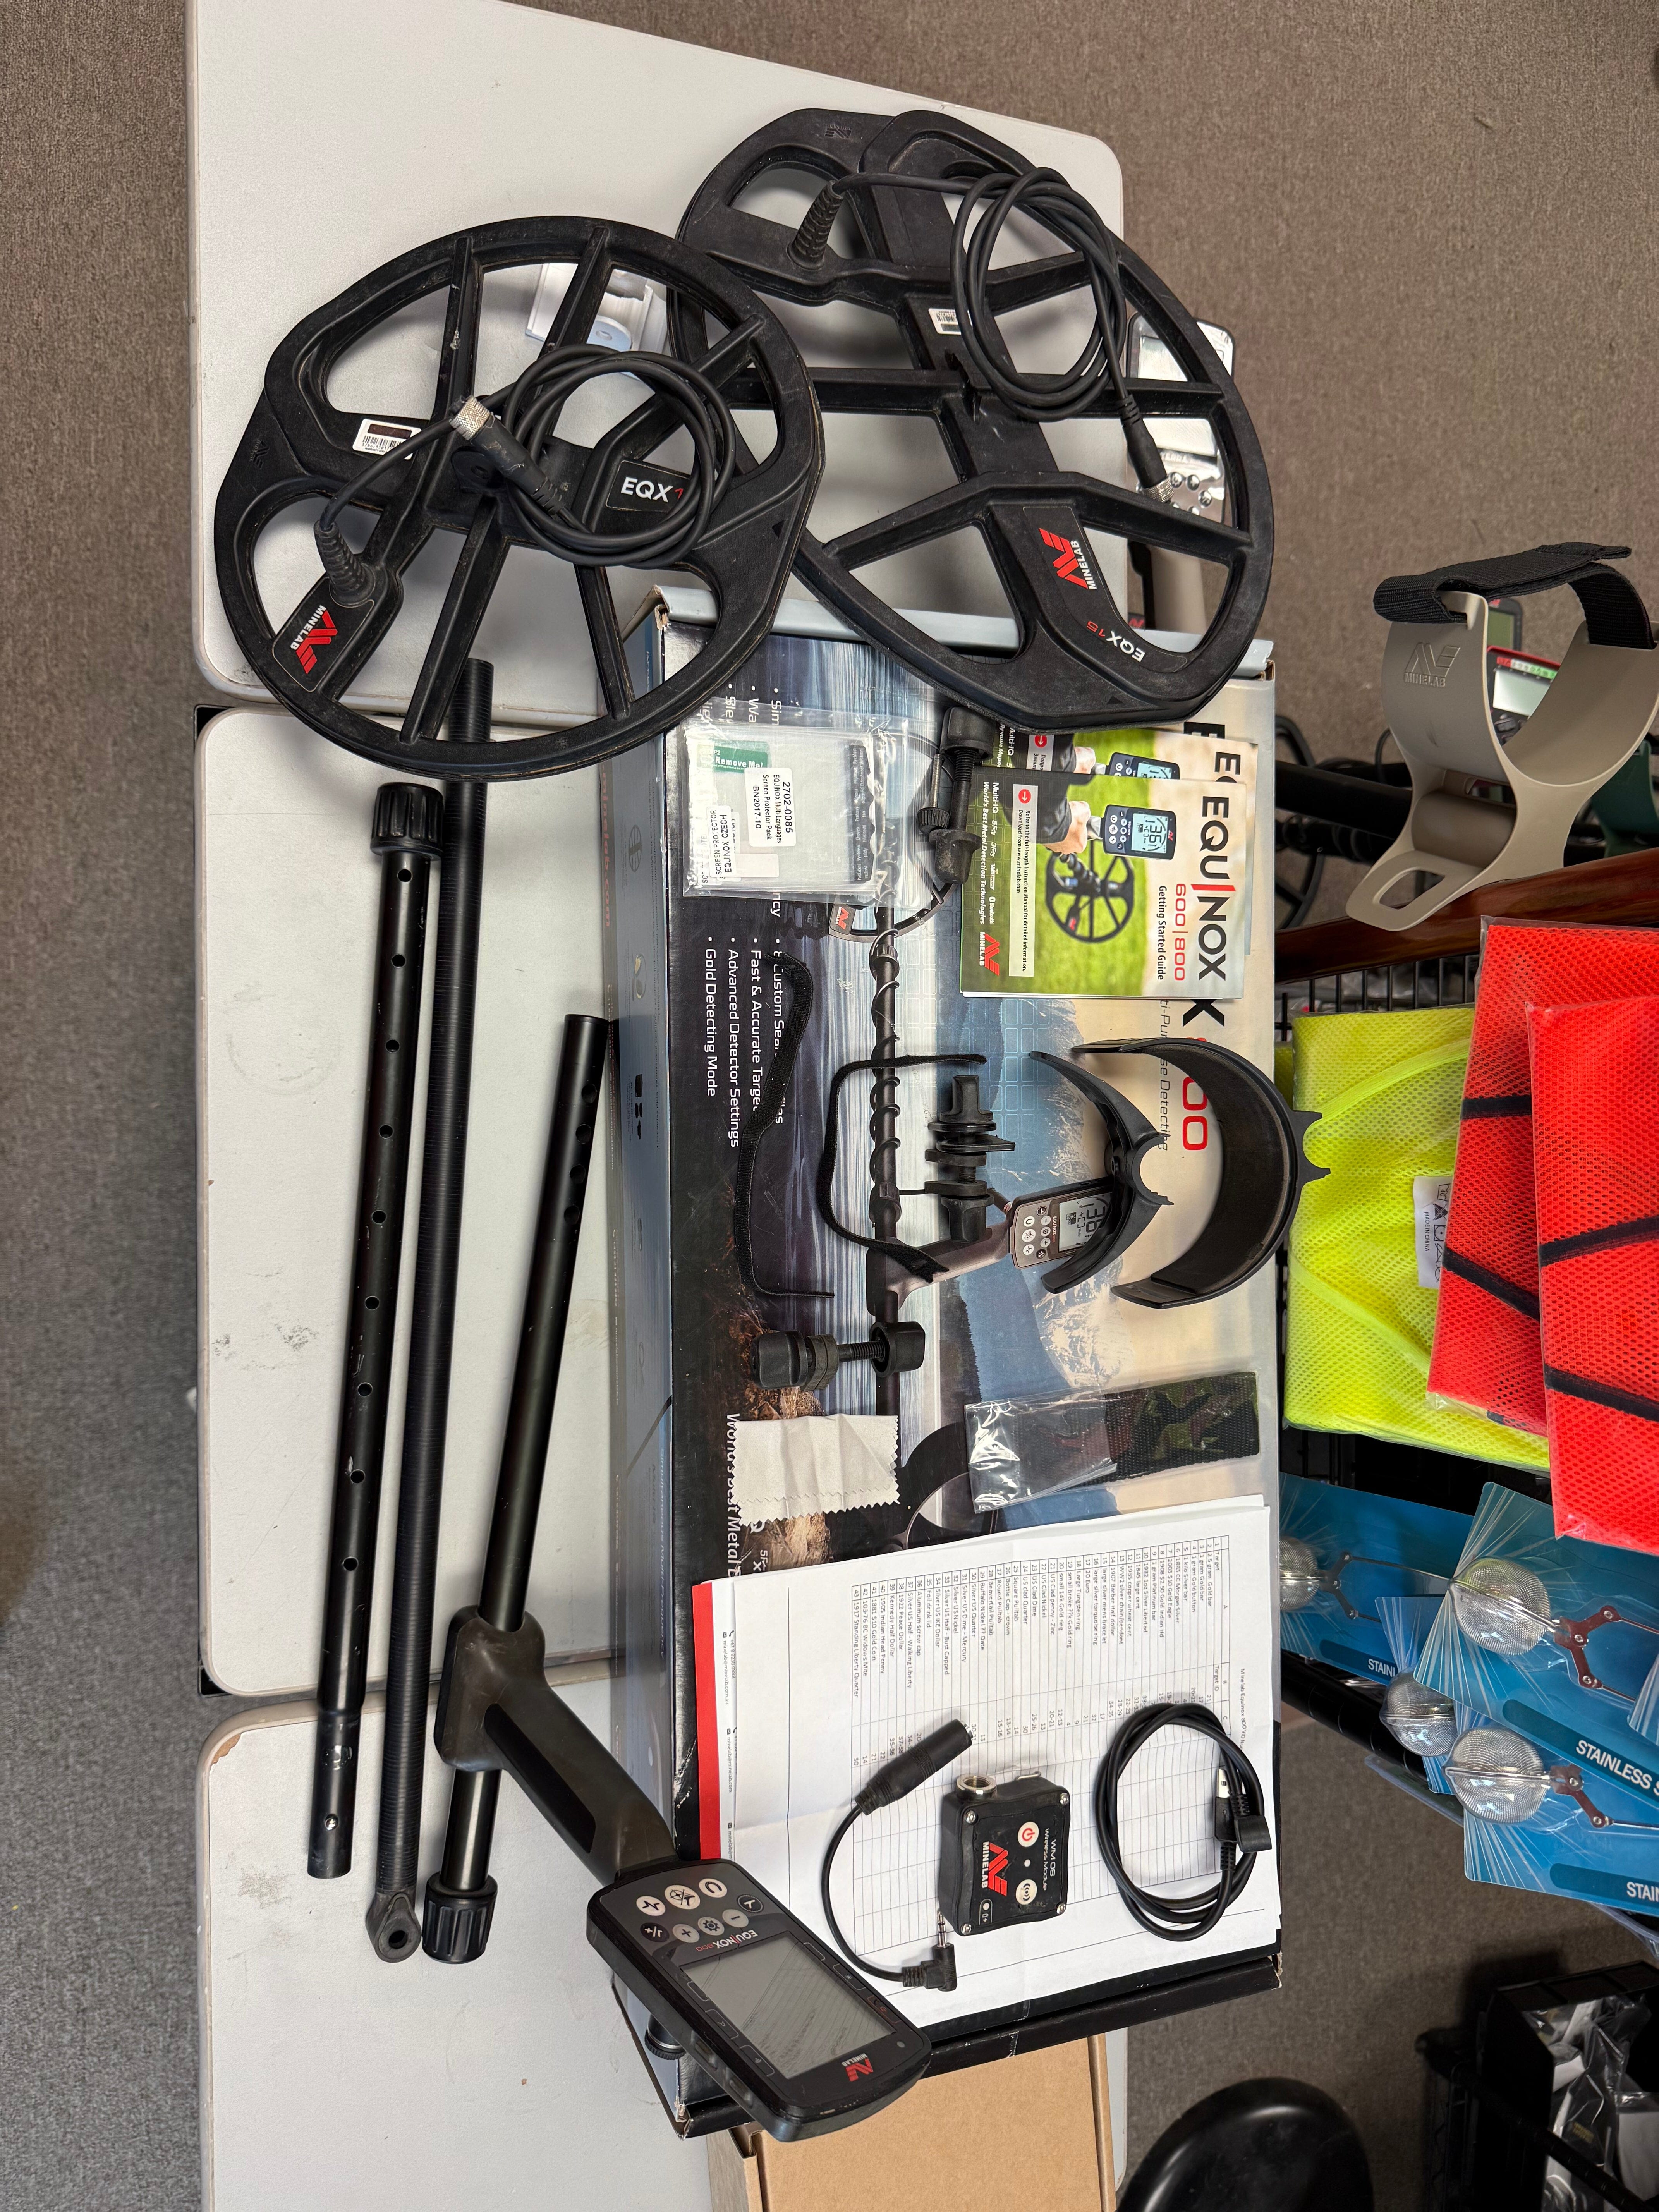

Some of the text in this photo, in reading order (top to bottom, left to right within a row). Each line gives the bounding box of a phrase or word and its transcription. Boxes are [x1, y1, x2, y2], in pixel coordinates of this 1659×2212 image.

[1070, 541, 1097, 589] MINELAB
[290, 605, 326, 651] MINELAB
[715, 756, 747, 768] Remove
[753, 786, 762, 828] BN2017-10
[783, 781, 793, 833] 2702-0085
[710, 810, 722, 875] SCREEN PROTECTOR
[720, 814, 732, 872] EQUINOX CZECH
[1191, 796, 1236, 981] EQUINOX
[1157, 886, 1167, 980] Getting Started Guide
[750, 950, 761, 982] Fast
[773, 964, 784, 1016] Custom
[751, 986, 762, 996] &
[704, 948, 718, 1096] Gold Detecting Mode
[752, 1000, 762, 1063] Accurate
[728, 949, 741, 1147] Advanced Detector Settings
[728, 1517, 741, 1563] Metal
[1576, 1740, 1653, 1790] STAINLESS
[981, 1841, 989, 1888] MINELAB
[1050, 1839, 1056, 1877] WM 08
[841, 2053, 867, 2067] MINELAB
